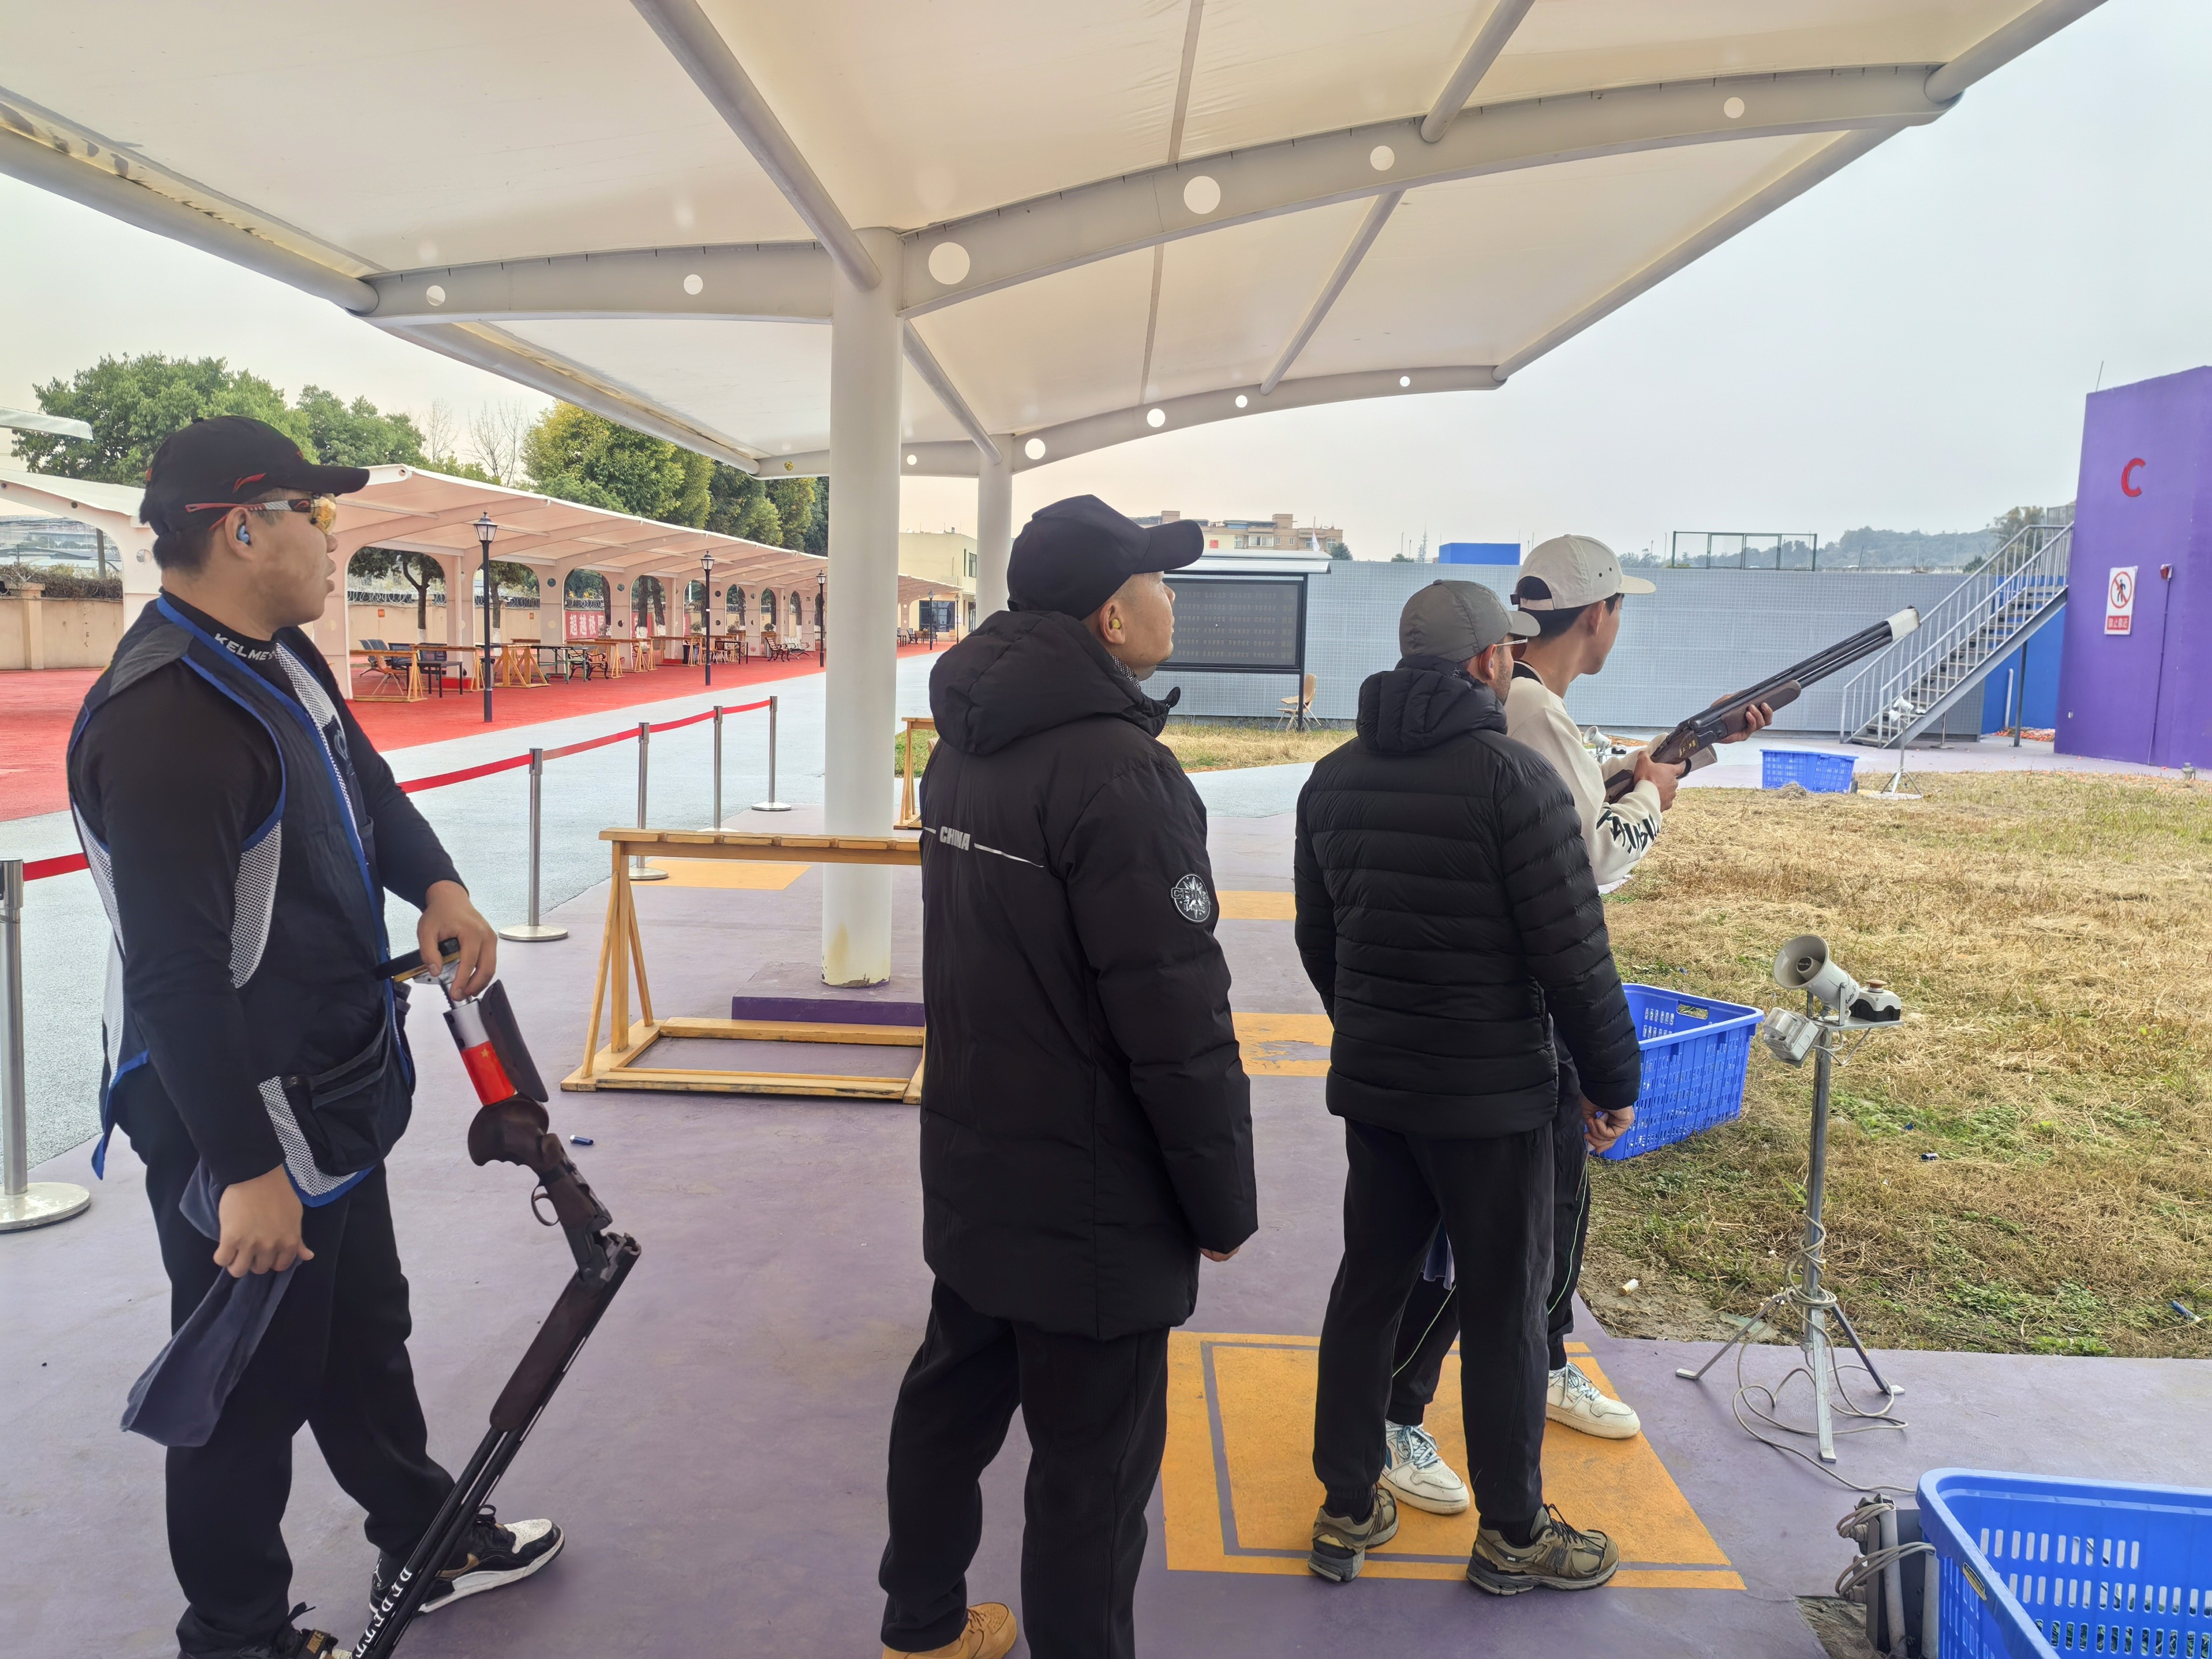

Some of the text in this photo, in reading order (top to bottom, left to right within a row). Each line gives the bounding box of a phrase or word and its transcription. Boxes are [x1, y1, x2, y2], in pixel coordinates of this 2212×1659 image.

[2121, 457, 2146, 497] C
[214, 633, 270, 660] KELME
[940, 826, 970, 851] CHINA
